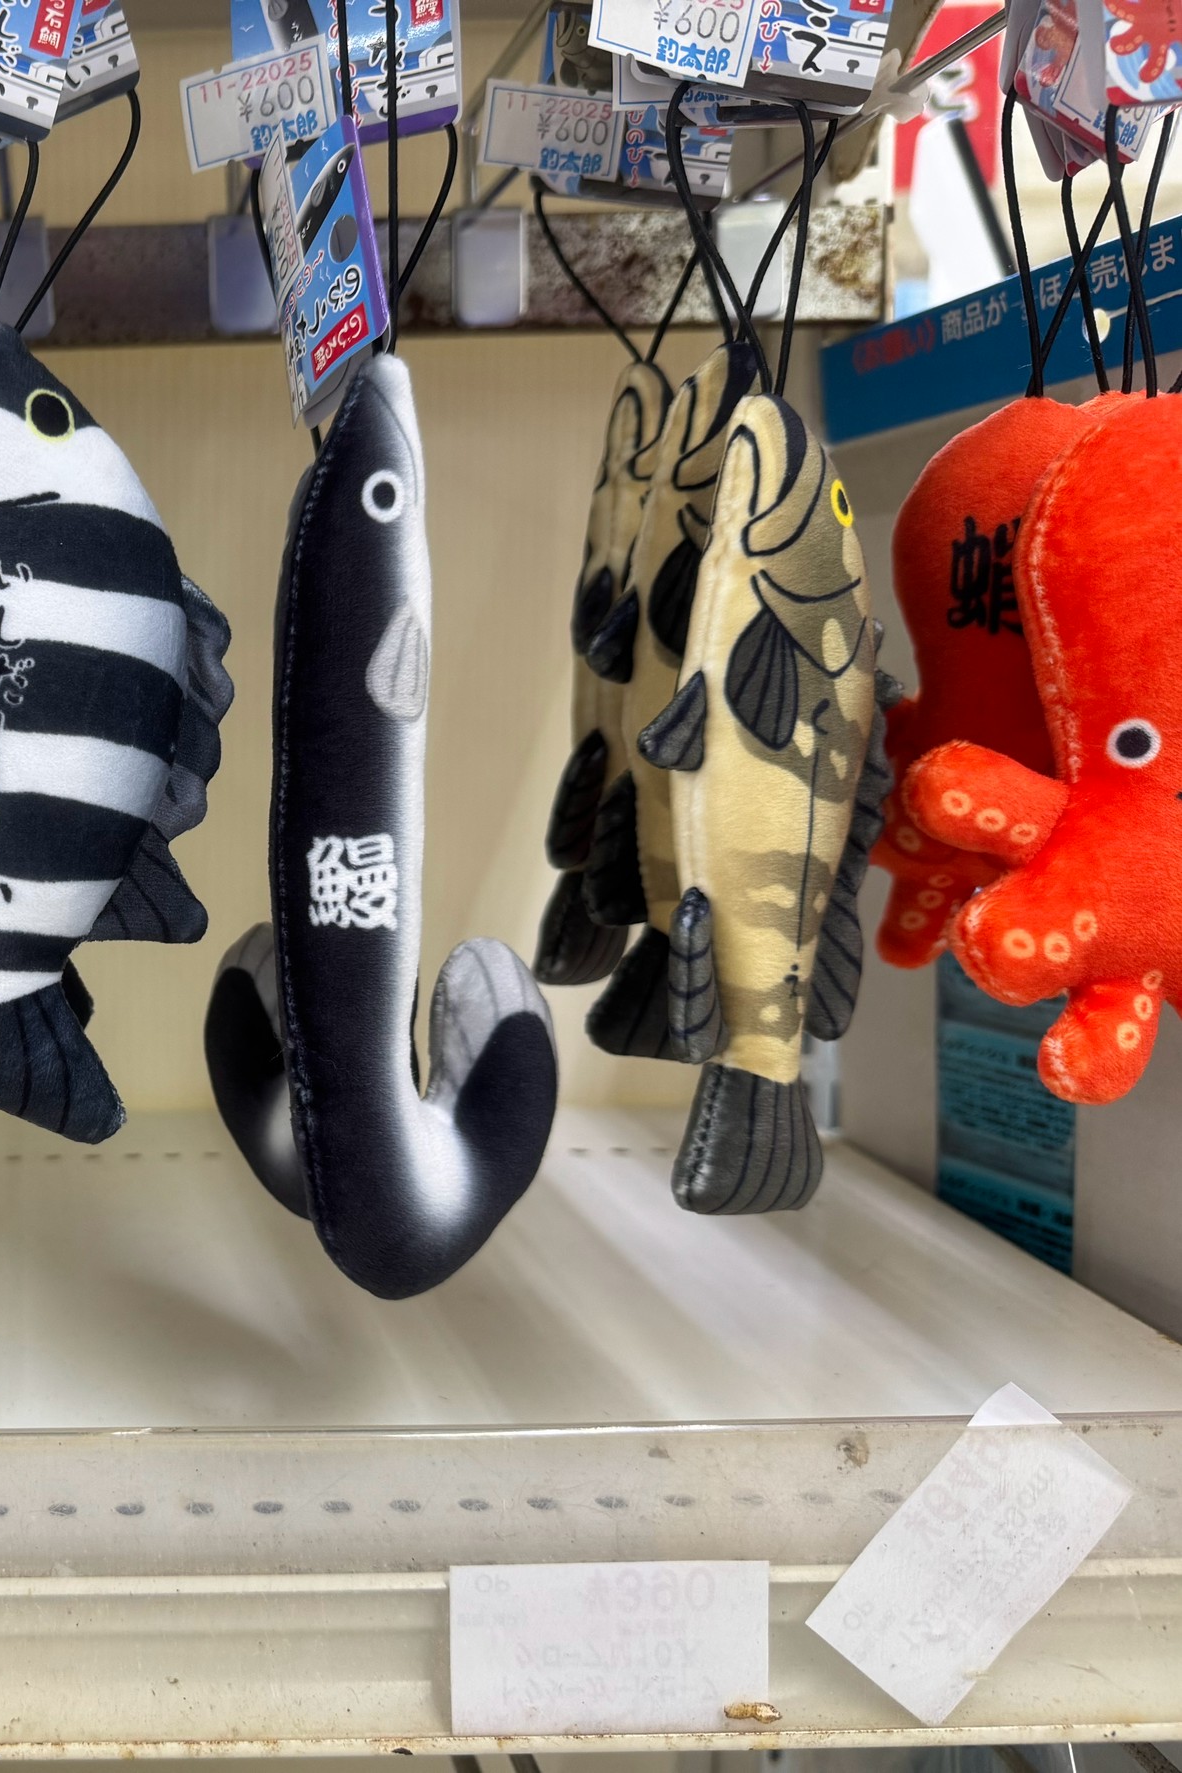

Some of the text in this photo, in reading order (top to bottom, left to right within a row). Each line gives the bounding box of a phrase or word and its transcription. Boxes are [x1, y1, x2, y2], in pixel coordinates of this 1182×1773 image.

[653, 0, 740, 43] ¥600
[656, 35, 731, 74] 釣太郎
[238, 75, 315, 123] ¥600
[537, 113, 608, 145] ¥600
[539, 147, 602, 174] 釣太郎
[306, 833, 398, 931] 鰻
